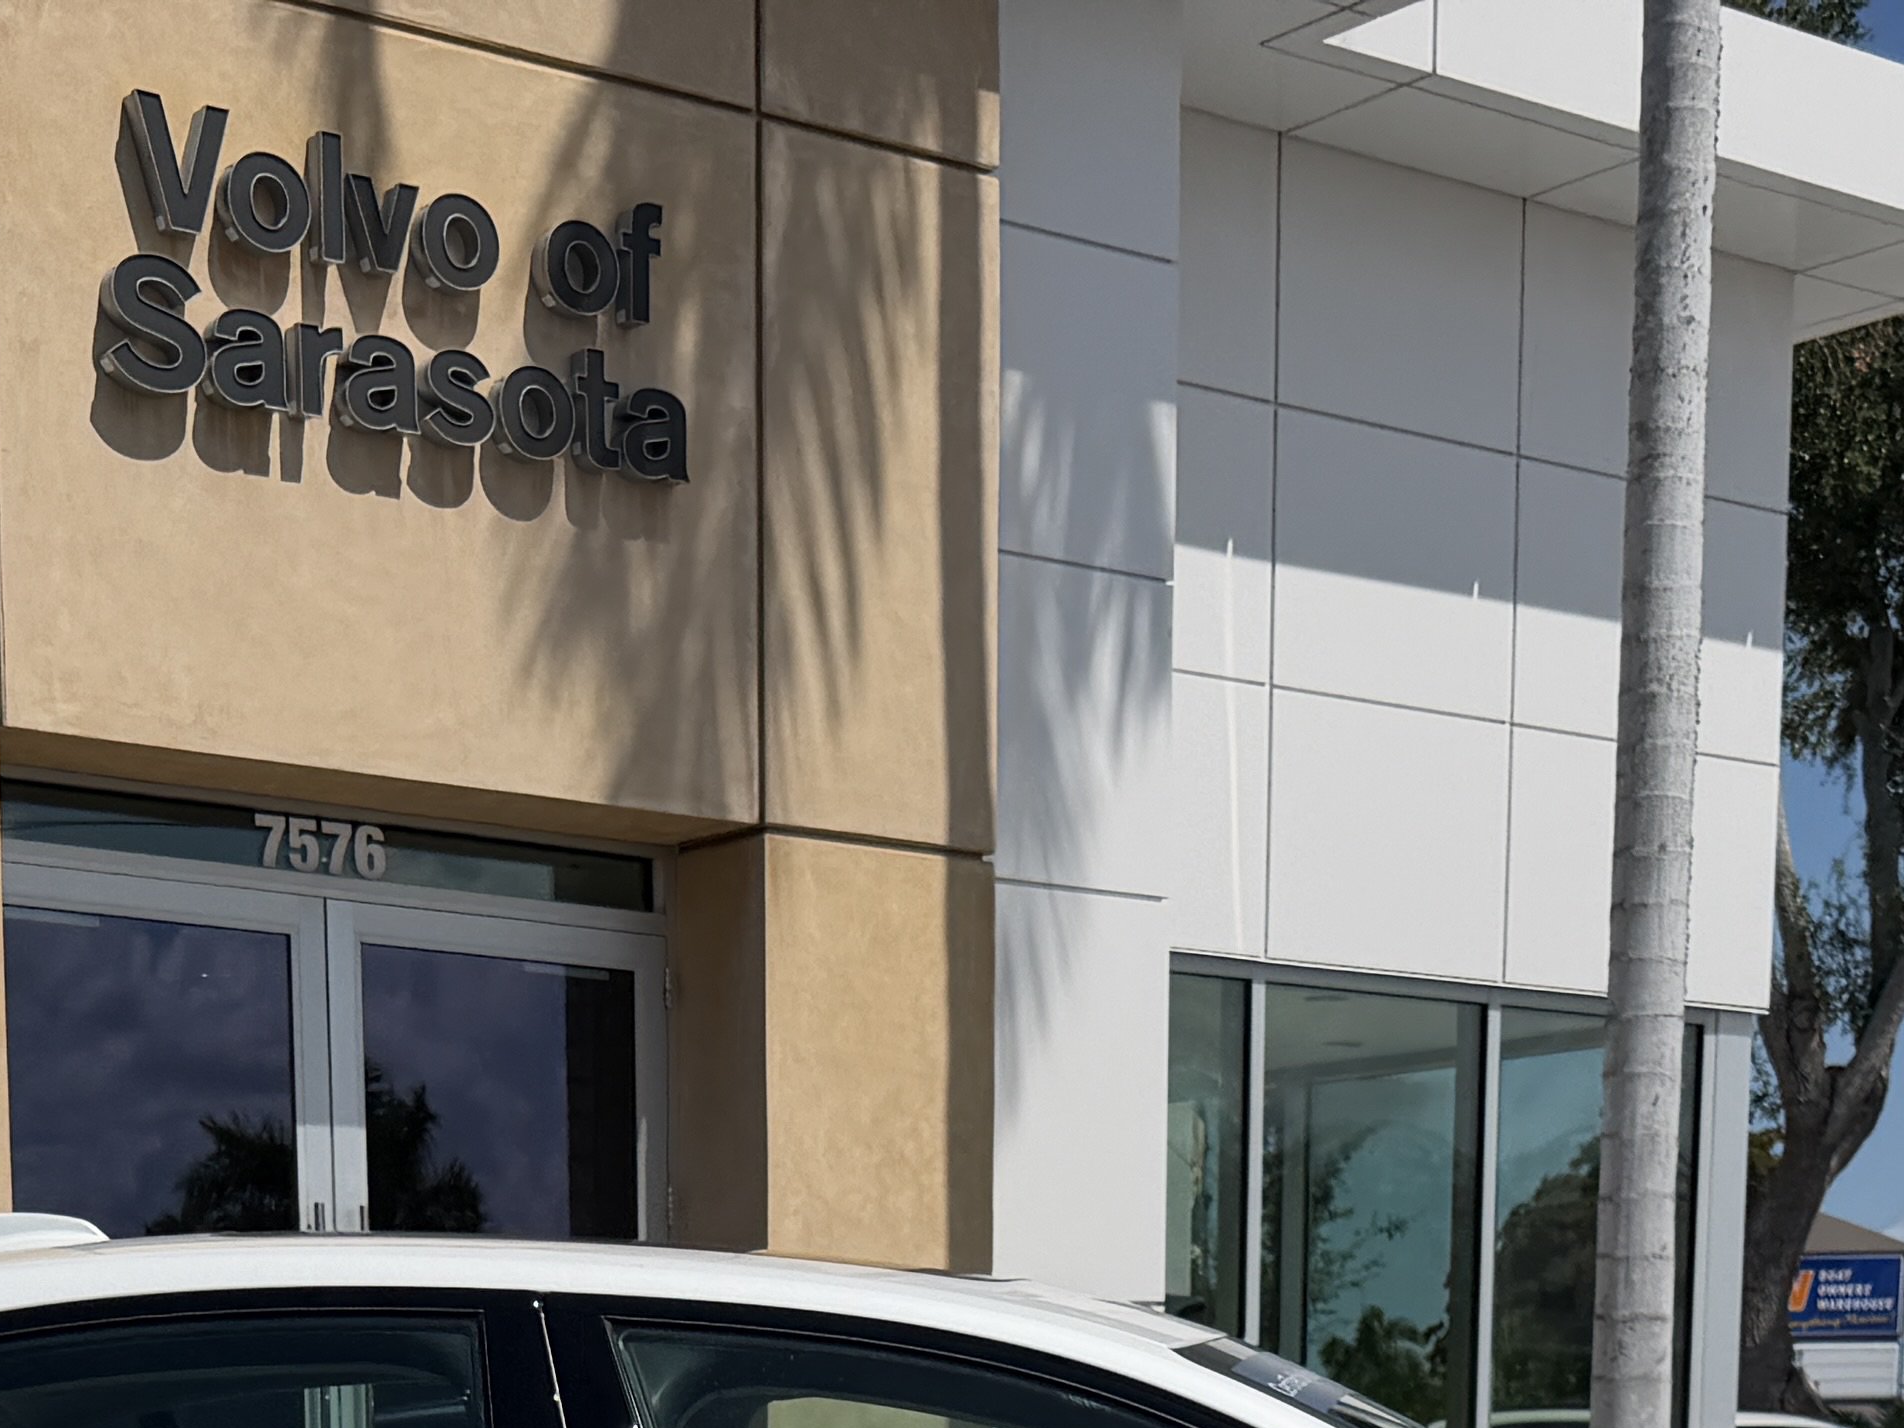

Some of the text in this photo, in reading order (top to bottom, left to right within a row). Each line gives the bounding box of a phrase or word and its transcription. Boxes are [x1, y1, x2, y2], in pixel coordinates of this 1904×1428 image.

[120, 88, 664, 328] Volvo of
[98, 253, 690, 484] Sarasota
[254, 813, 387, 880] 7576
